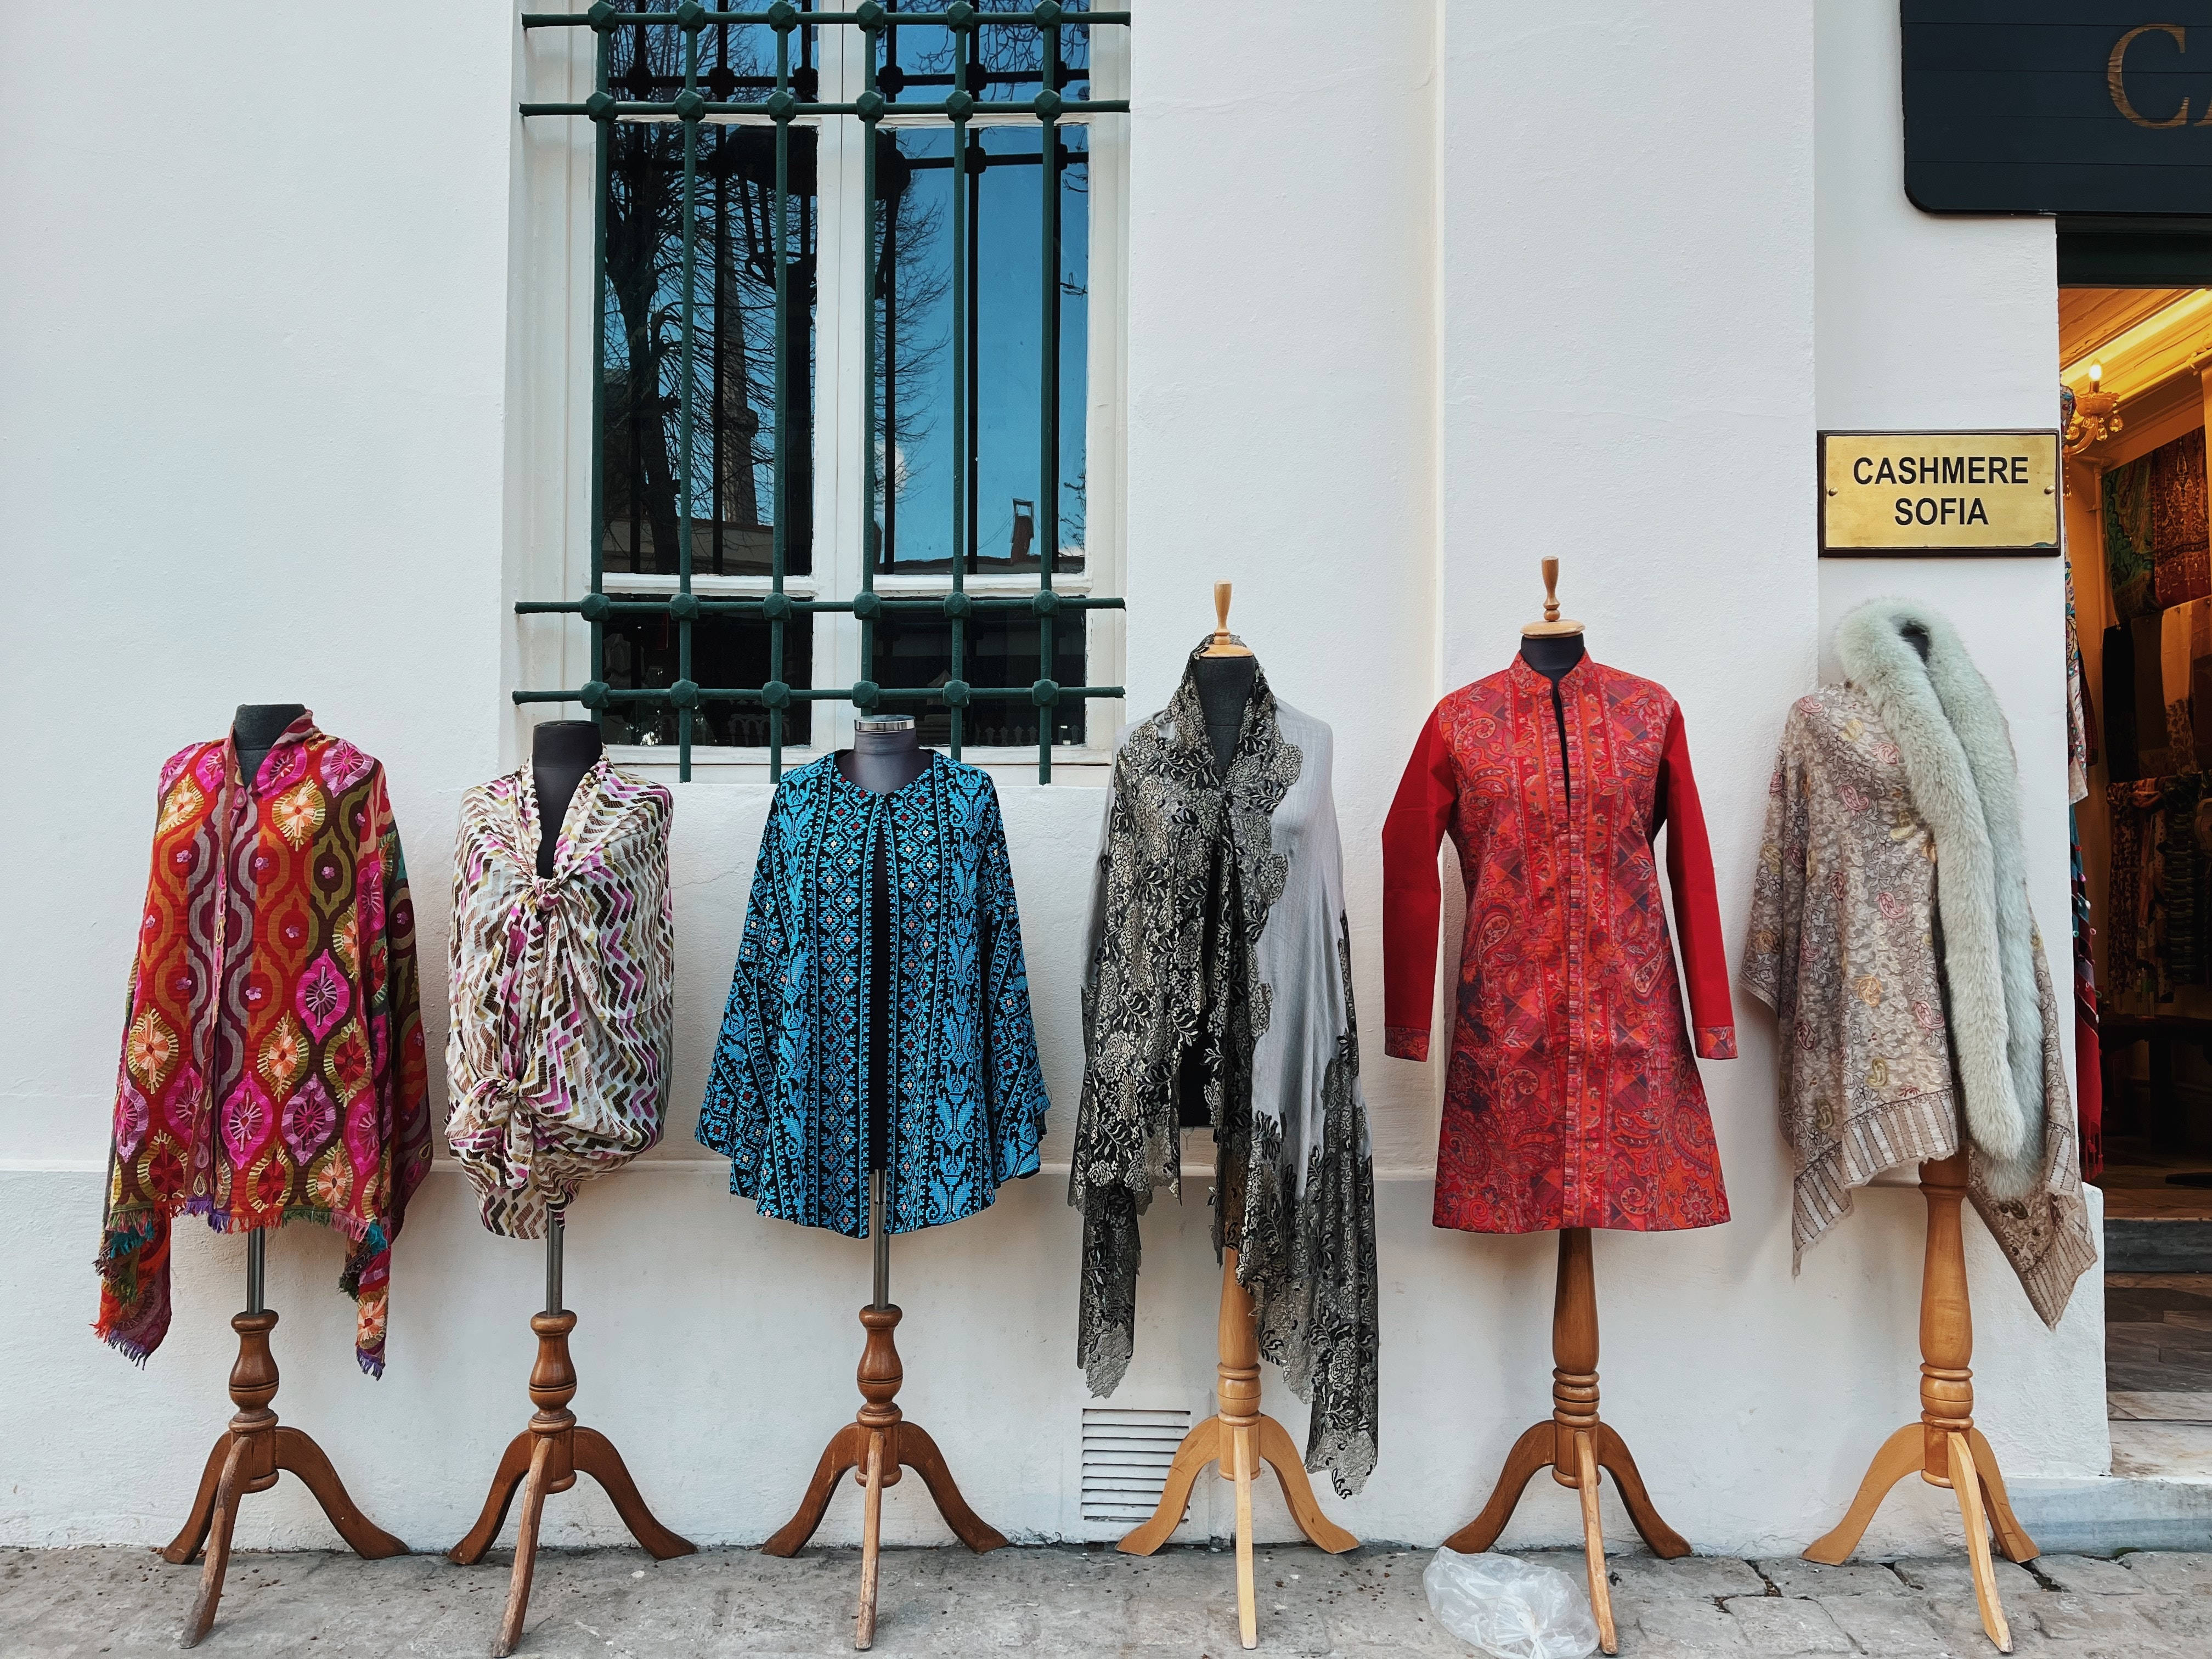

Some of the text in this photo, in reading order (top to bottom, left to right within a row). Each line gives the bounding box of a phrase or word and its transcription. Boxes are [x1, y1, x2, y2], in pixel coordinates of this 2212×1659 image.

[2107, 24, 2212, 129] C
[1853, 456, 2029, 484] CASHMERE
[1894, 498, 1989, 525] SOFIA
